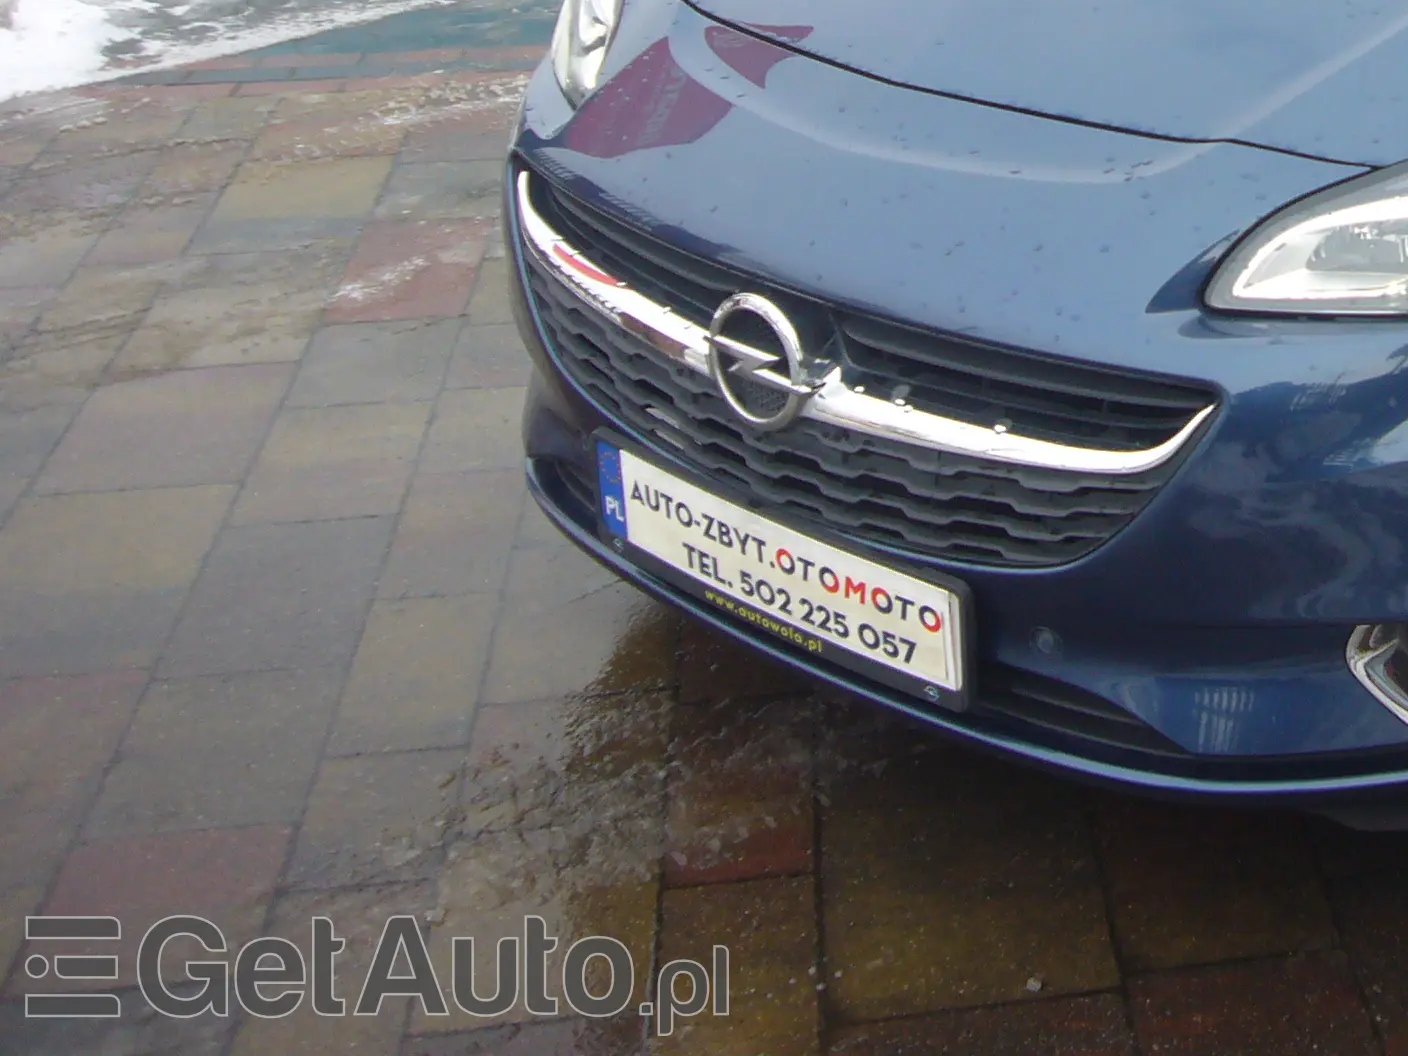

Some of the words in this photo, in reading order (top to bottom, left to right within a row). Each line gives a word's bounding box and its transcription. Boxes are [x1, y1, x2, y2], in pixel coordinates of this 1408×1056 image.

[604, 495, 624, 522] PL
[682, 542, 733, 588] TEL.
[740, 569, 792, 616] 502
[799, 597, 850, 639] 225
[858, 622, 917, 664] 057
